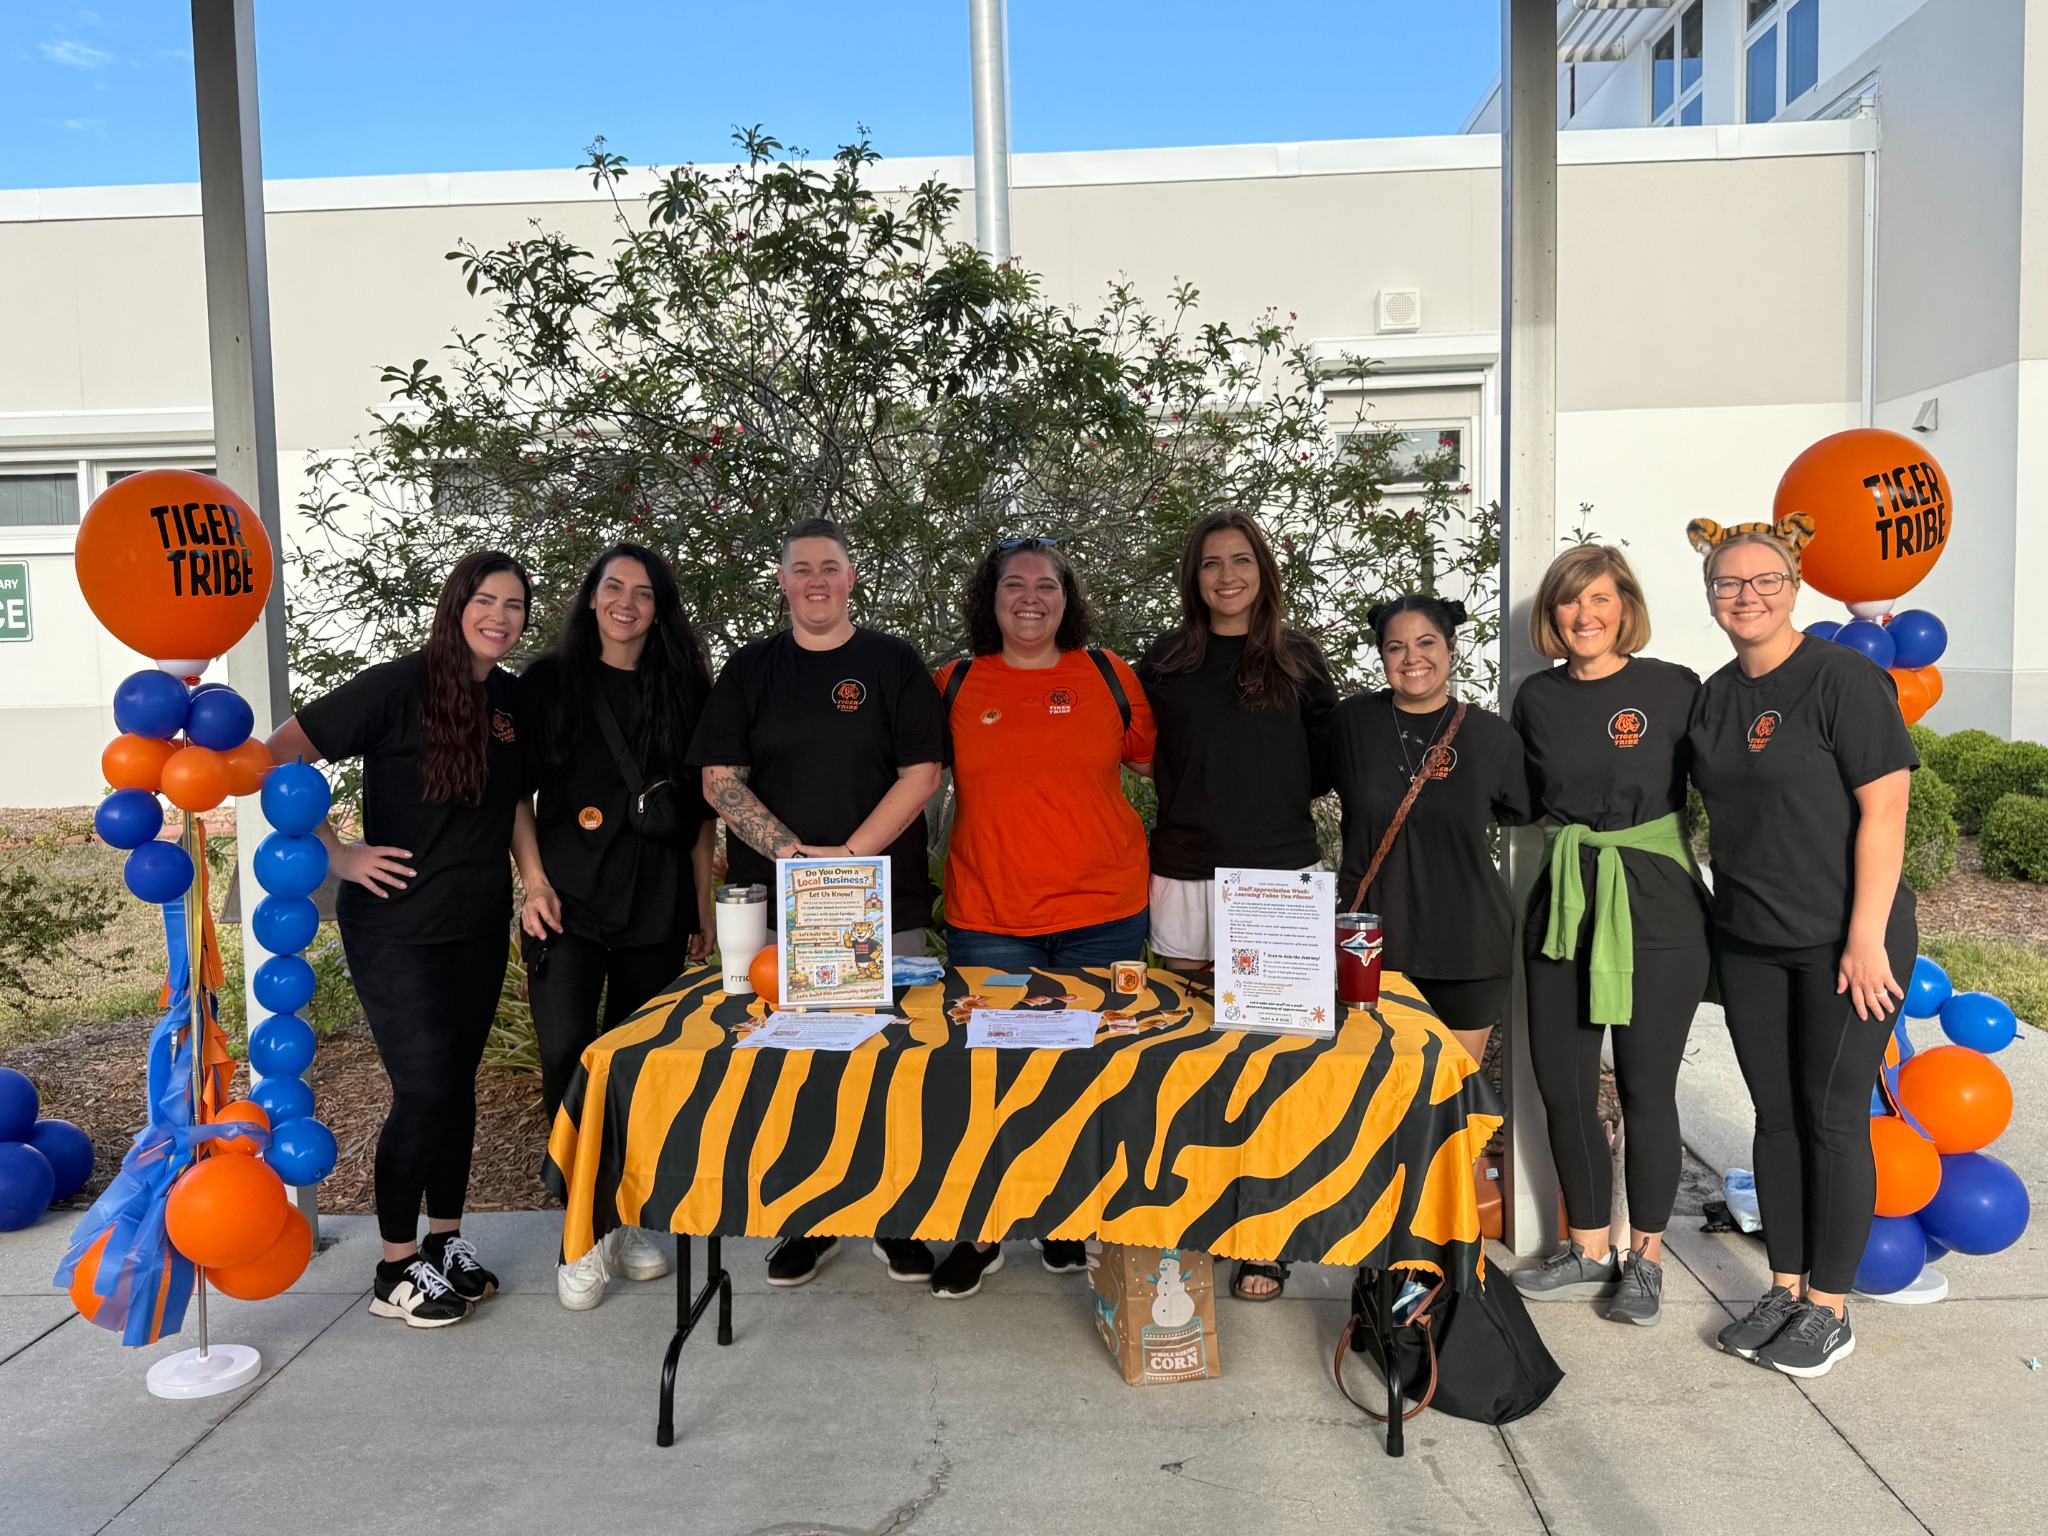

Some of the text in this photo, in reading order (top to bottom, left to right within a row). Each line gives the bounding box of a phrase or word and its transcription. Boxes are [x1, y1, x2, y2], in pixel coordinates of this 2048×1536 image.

[1863, 462, 1944, 518] TIGER
[150, 502, 246, 549] TIGER
[1875, 504, 1946, 560] TRIBE
[167, 548, 254, 596] TRIBE
[797, 876, 869, 887] Local Business?
[1150, 1352, 1198, 1370] CORN
